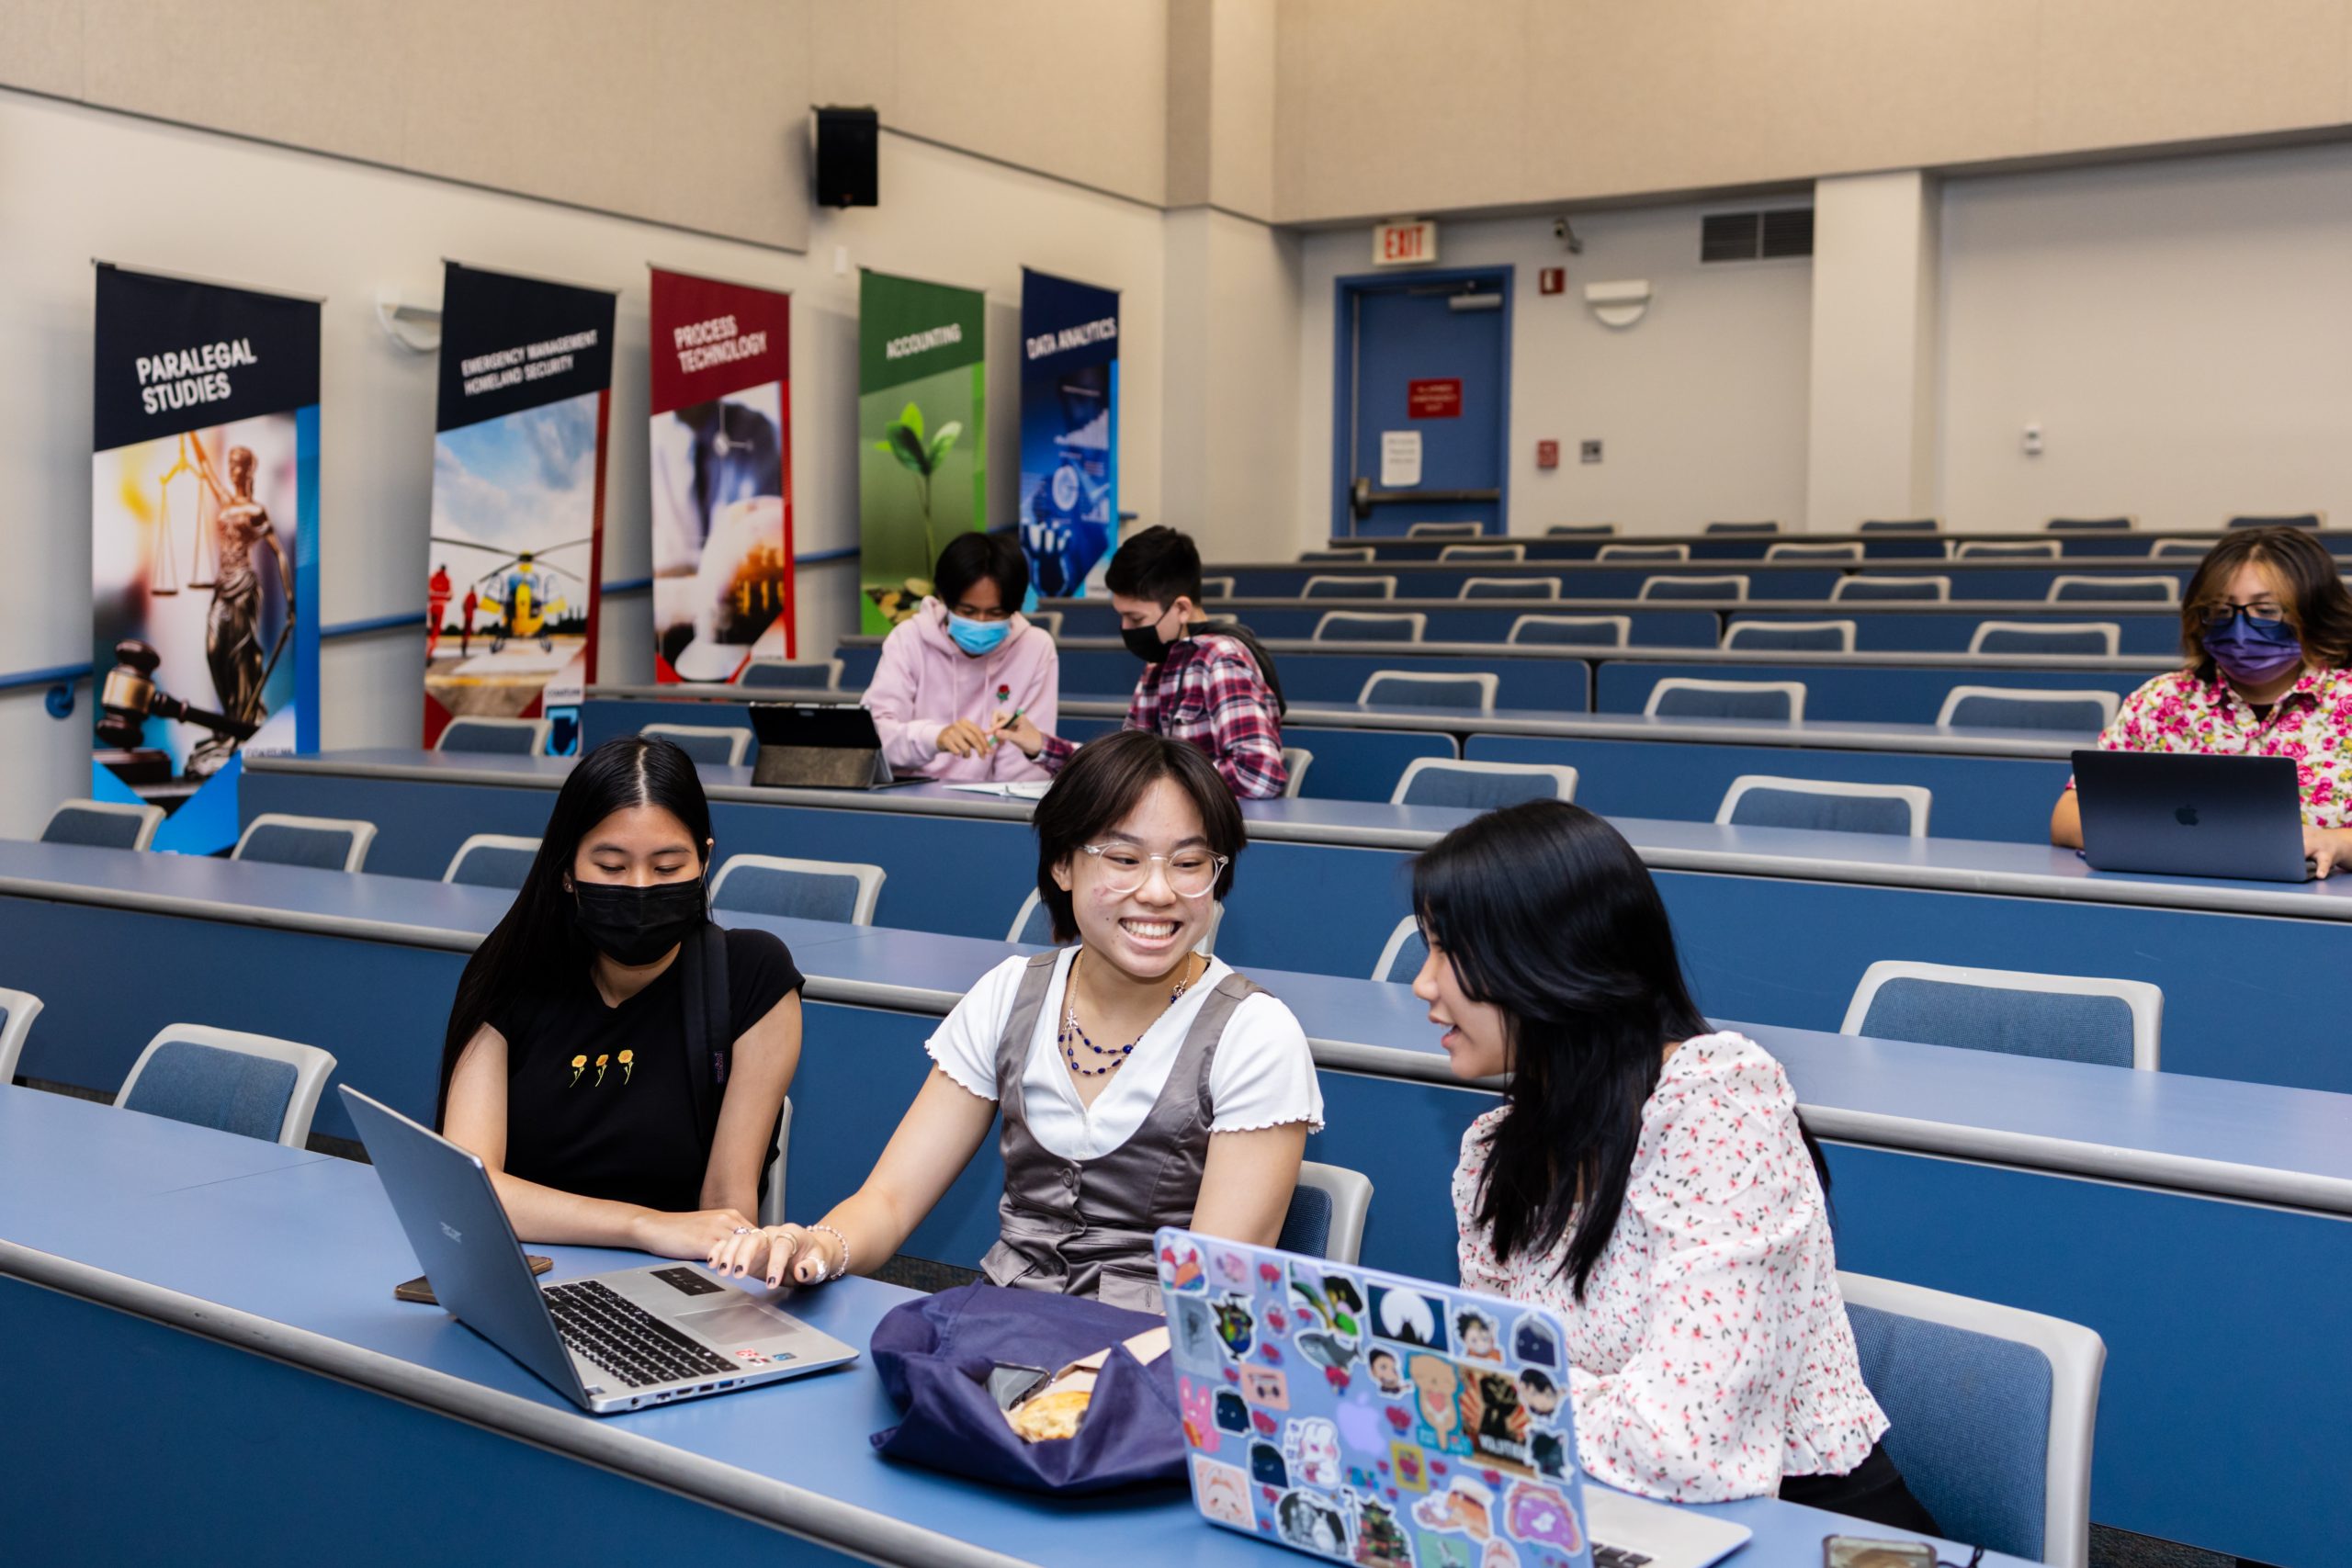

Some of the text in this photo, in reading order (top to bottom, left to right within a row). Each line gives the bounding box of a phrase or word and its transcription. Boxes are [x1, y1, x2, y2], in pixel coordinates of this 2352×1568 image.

[1384, 226, 1425, 261] EXIT
[460, 328, 598, 378] EMERGENCY MANAGEMENT
[673, 314, 739, 350] PROCESS
[677, 330, 767, 375] TECHNOLOGY
[886, 322, 962, 361] ACCOUNTING
[1026, 317, 1117, 360] DATA ANALYTICS
[136, 337, 257, 386] PARALEGAL
[463, 354, 574, 397] HOMELAND SECURITY
[141, 371, 232, 414] STUDIES
